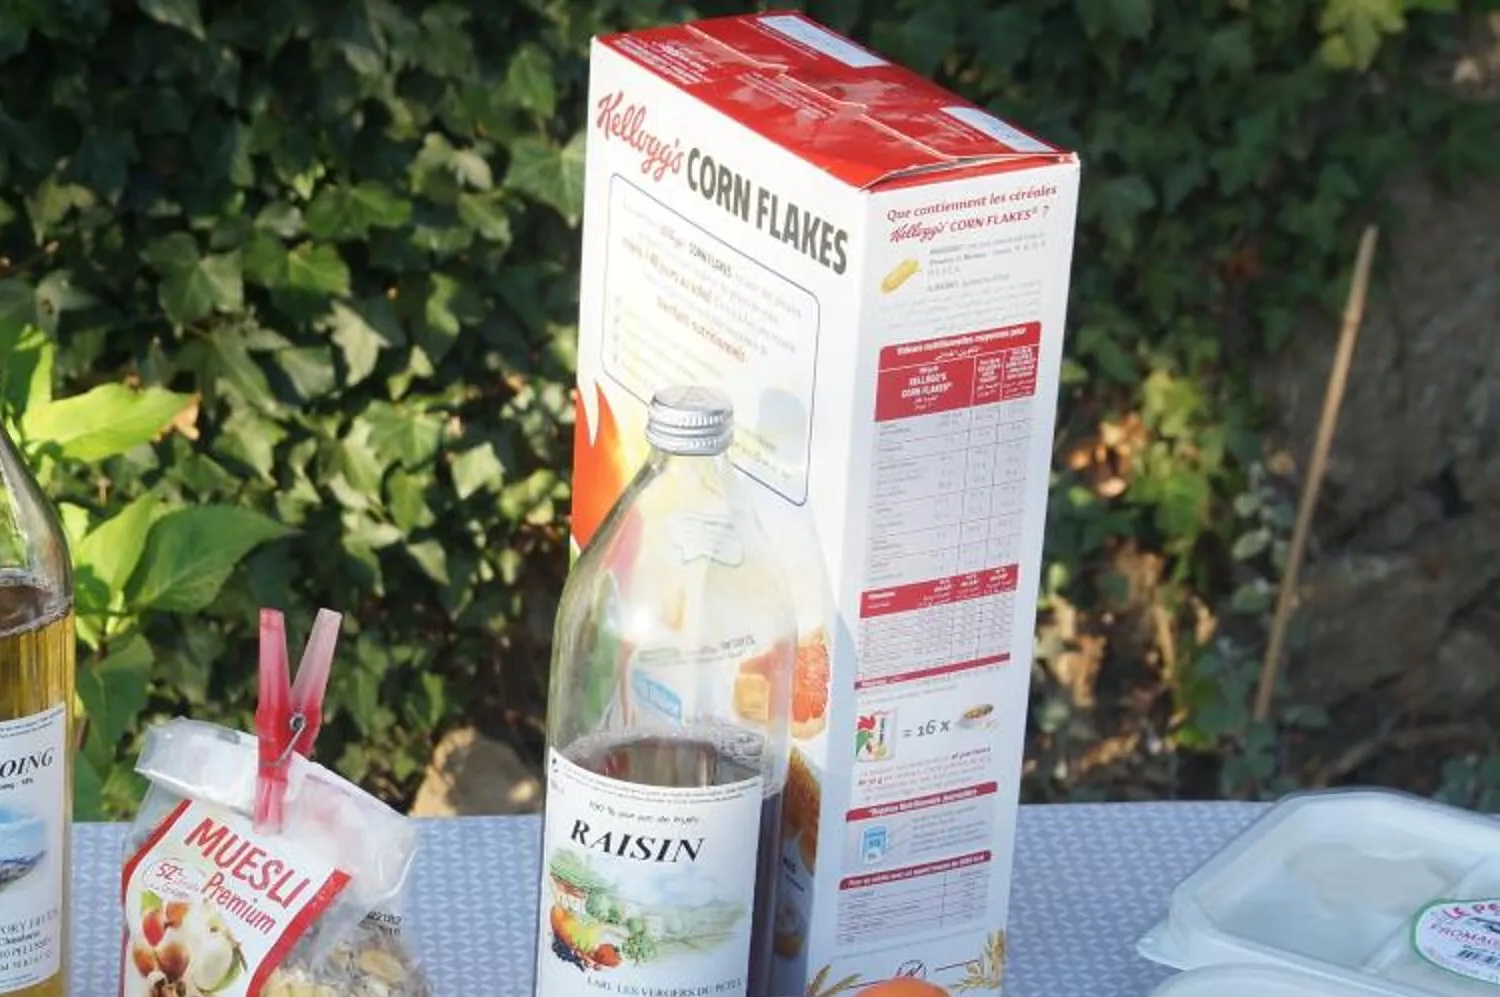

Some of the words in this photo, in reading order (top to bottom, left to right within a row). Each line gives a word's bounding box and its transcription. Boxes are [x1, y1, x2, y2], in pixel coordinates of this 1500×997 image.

[597, 90, 685, 181] Kellogg's
[686, 146, 751, 223] CORN
[755, 187, 849, 276] FLAKES
[887, 207, 910, 222] Que
[913, 196, 987, 217] contiennent
[989, 191, 1007, 206] les
[949, 219, 984, 233] CORN
[184, 817, 311, 910] MUESLI
[570, 819, 705, 863] RAISIN
[200, 871, 277, 935] Premium
